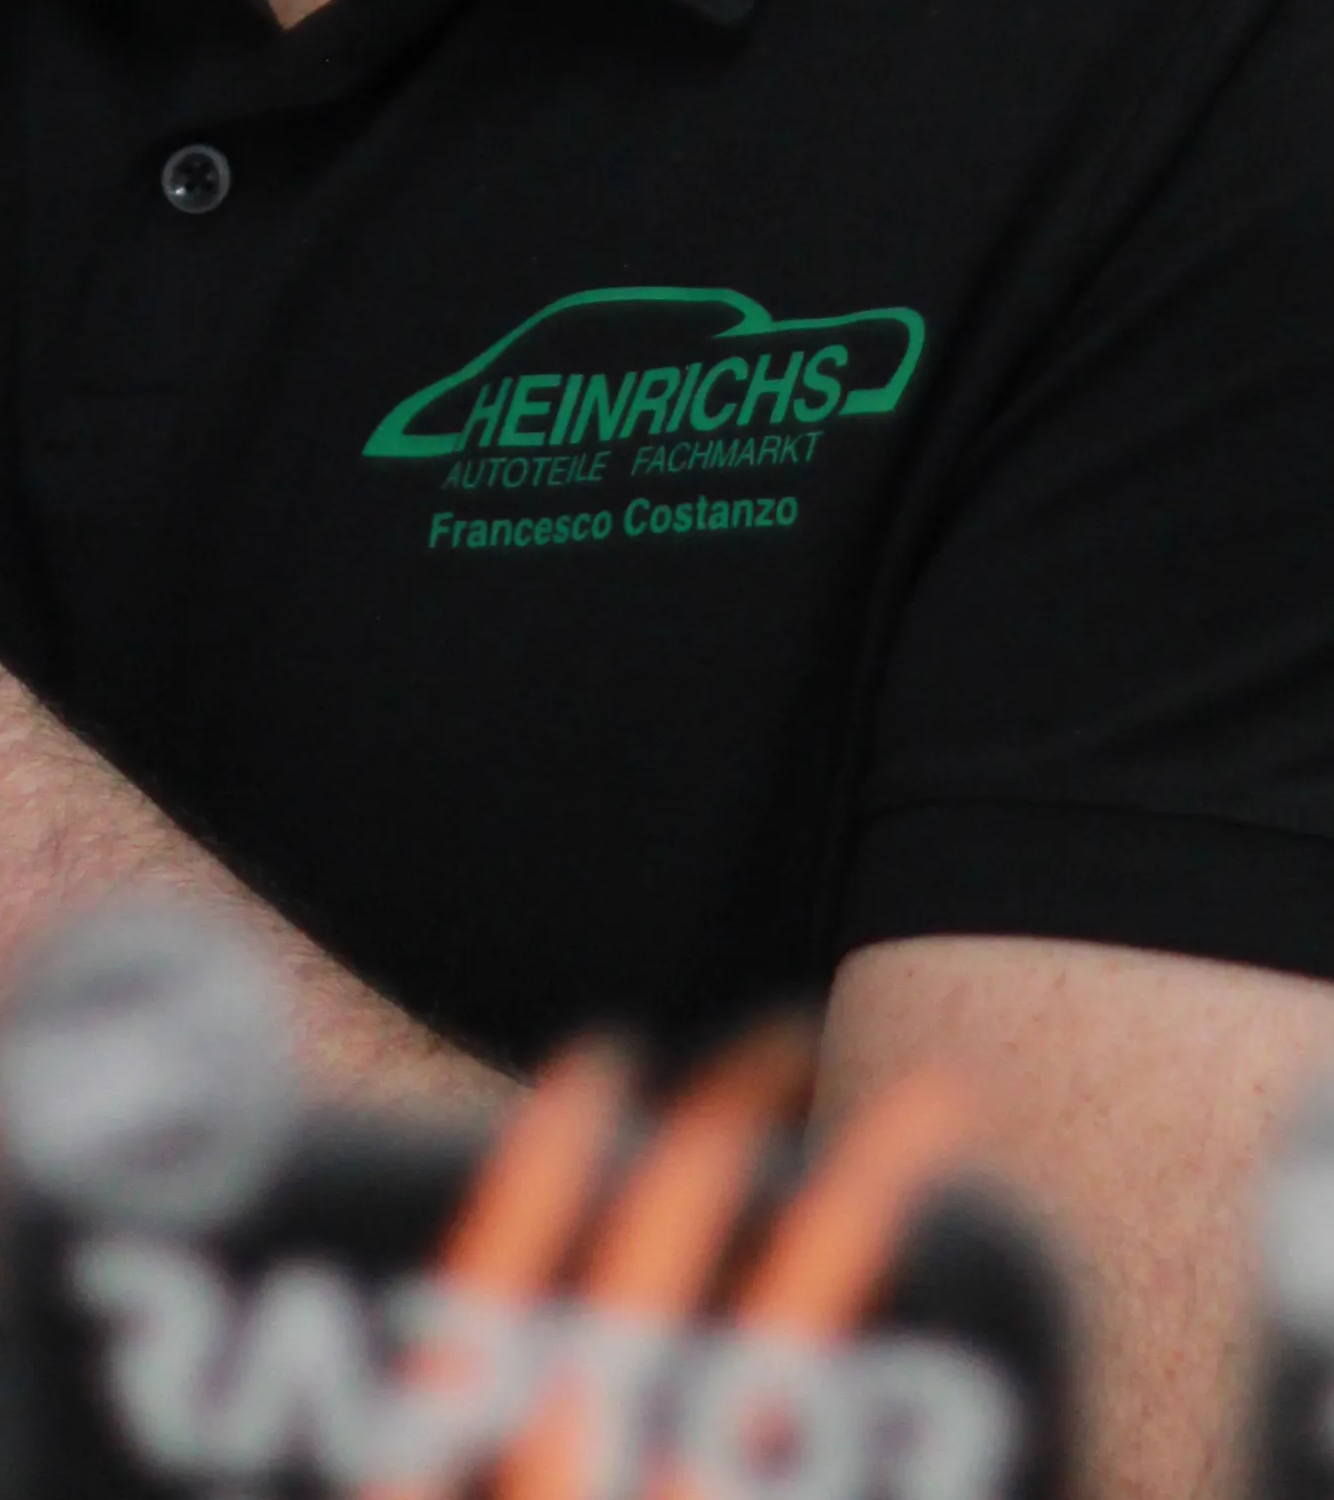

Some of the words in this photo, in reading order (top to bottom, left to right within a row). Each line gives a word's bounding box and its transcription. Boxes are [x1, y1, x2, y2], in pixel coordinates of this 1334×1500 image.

[457, 344, 849, 451] HEINRICHS
[443, 451, 611, 490] AUTOTEILE
[631, 431, 823, 476] FACHMARKT
[428, 510, 613, 549] Francesco
[624, 495, 798, 537] Costanzo
